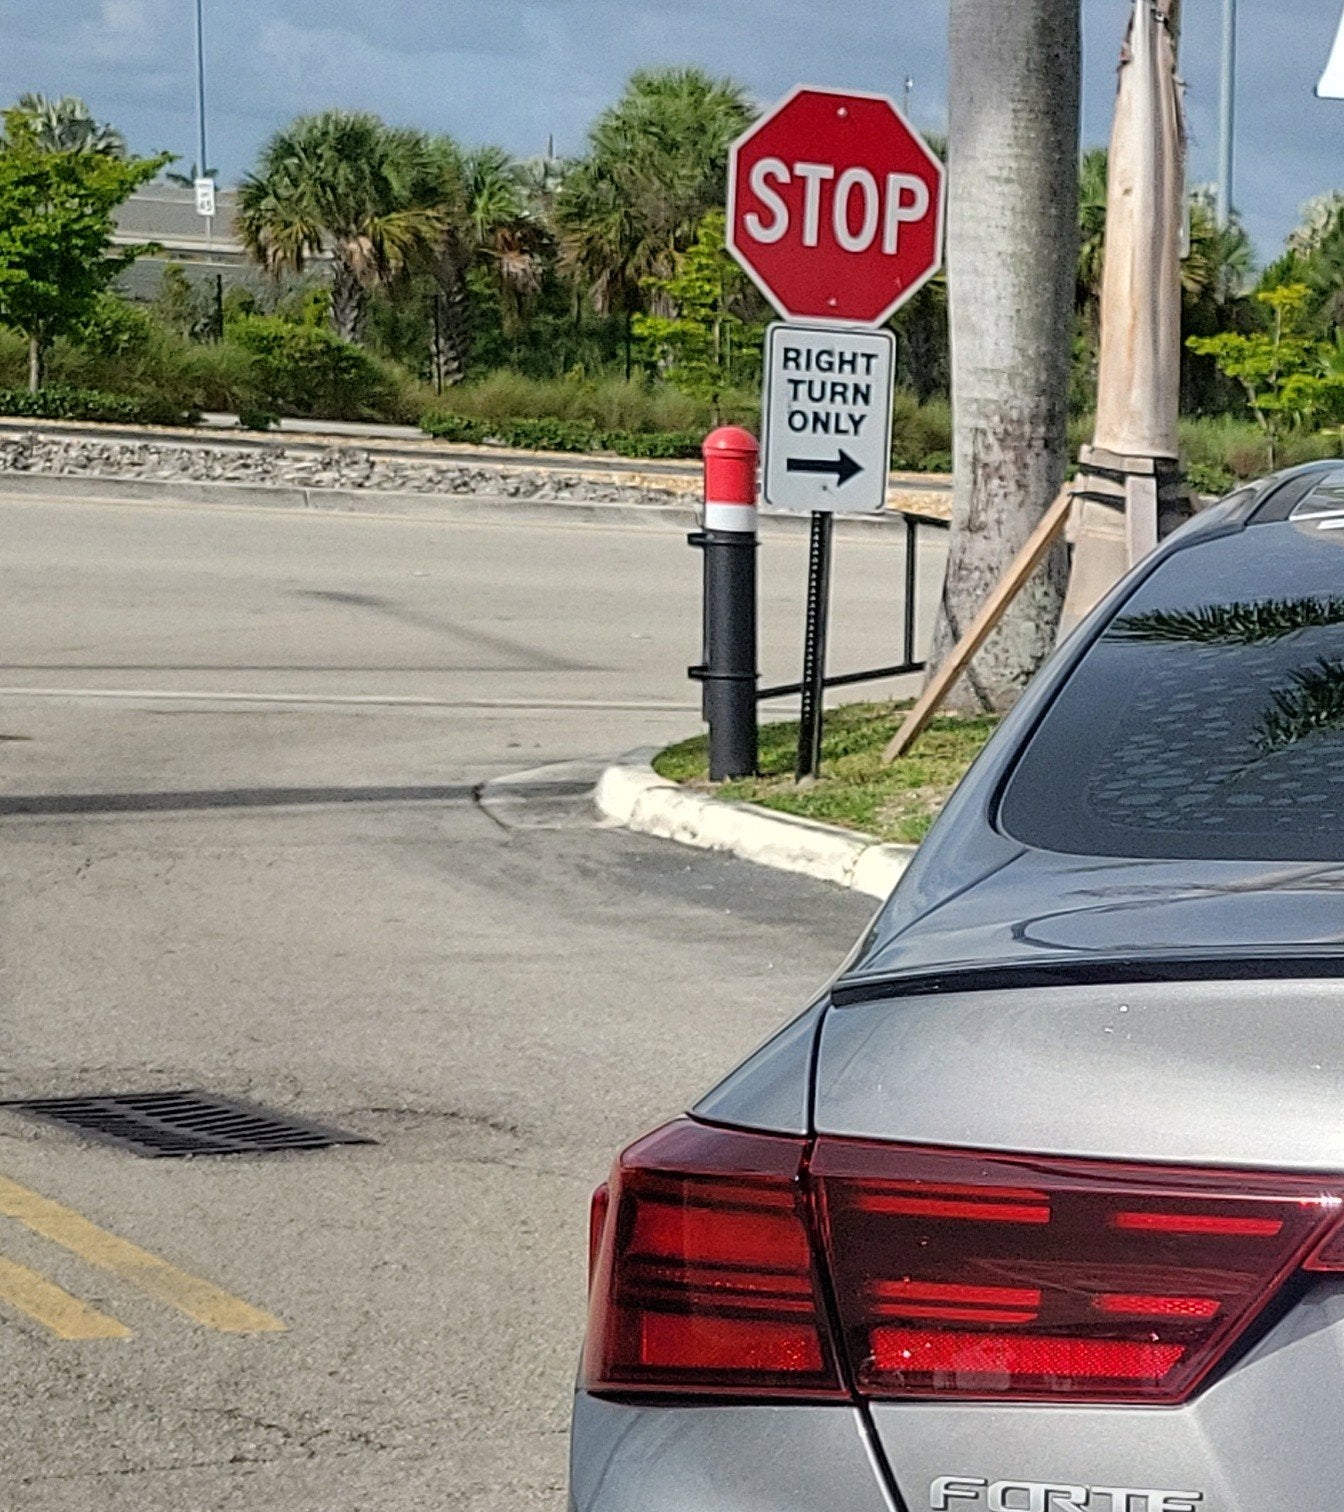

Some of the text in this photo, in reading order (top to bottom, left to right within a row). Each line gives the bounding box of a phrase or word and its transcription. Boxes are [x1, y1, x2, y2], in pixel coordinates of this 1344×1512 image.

[744, 156, 929, 255] STOP
[782, 347, 878, 375] RIGHT
[787, 379, 871, 406] TURN
[787, 411, 867, 436] ONLY
